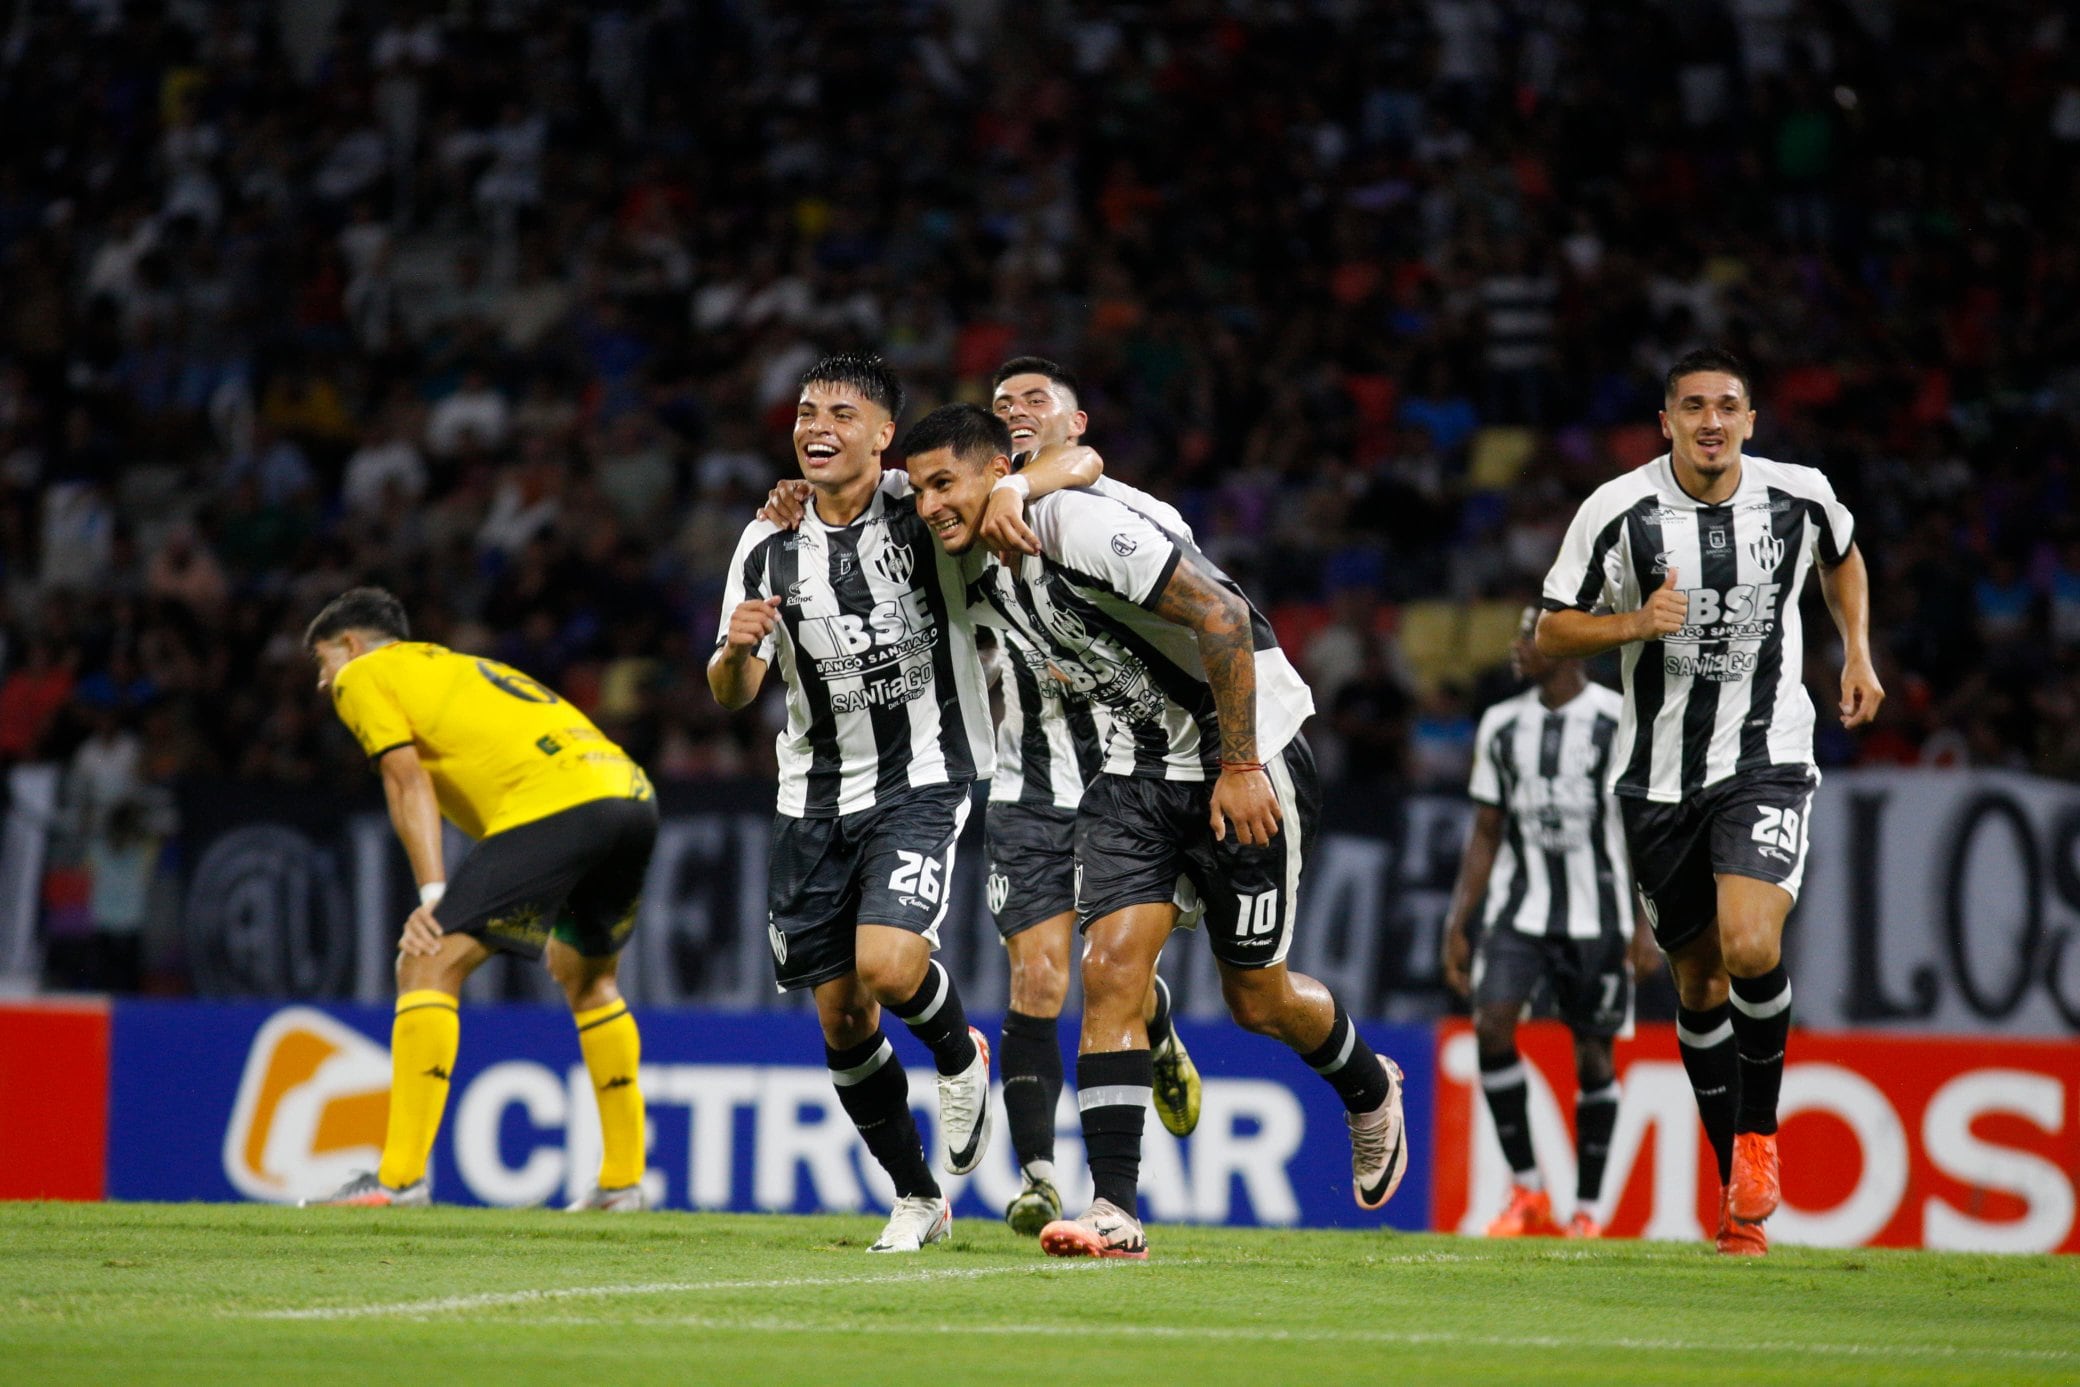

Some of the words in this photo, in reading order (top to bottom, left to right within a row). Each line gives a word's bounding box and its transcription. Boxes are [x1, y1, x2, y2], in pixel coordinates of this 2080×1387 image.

[828, 587, 935, 657] BSE
[1688, 583, 1781, 625] BSE
[815, 656, 863, 673] BANCO
[868, 627, 938, 664] SANTIAGO
[1751, 805, 1799, 854] 29
[888, 849, 942, 904] 26
[1236, 888, 1278, 936] 10
